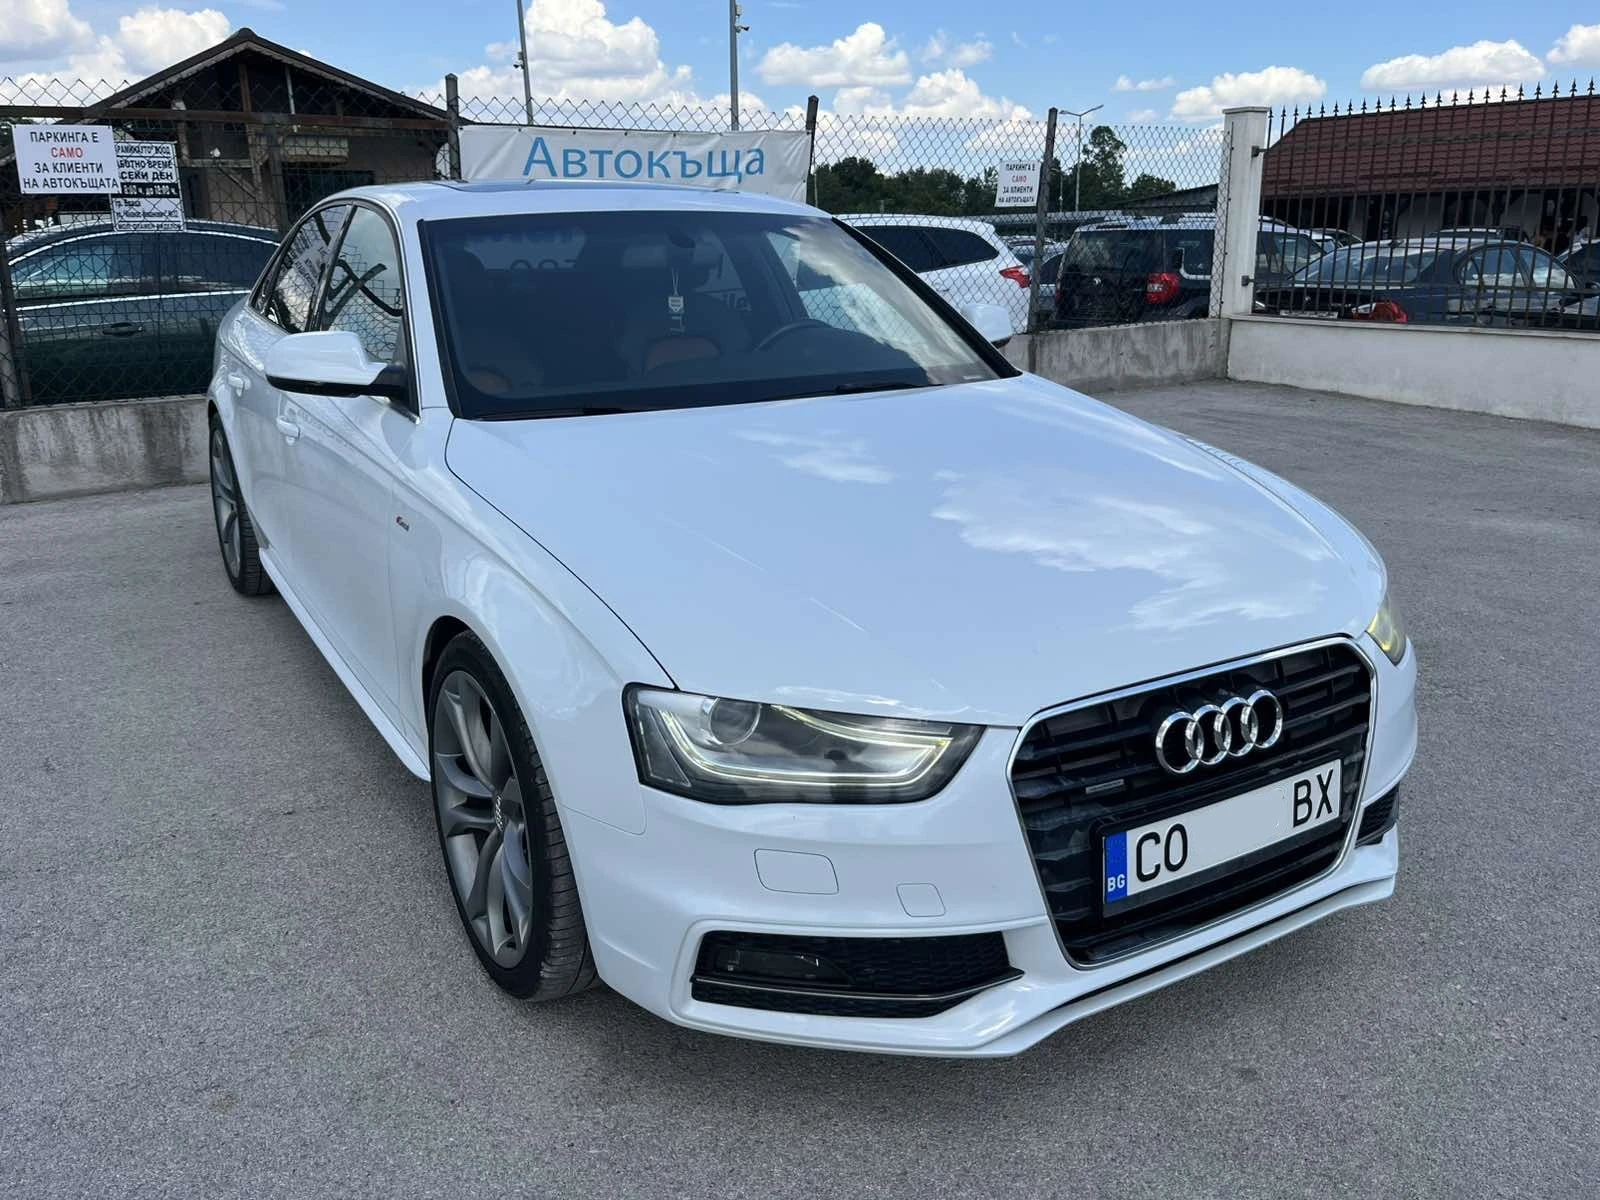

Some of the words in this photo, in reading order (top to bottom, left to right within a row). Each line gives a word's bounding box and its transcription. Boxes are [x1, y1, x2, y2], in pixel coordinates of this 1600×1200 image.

[30, 131, 89, 143] ПАРКИНГА
[92, 132, 99, 143] Е
[51, 146, 83, 158] САМО
[523, 136, 765, 184] Автокъща
[34, 162, 50, 174] ЗА
[52, 162, 104, 174] КЛИЕНТИ
[119, 171, 148, 181] СЕКИ
[23, 178, 39, 189] НА
[42, 177, 119, 190] АВТОКЪЩАТА
[1107, 873, 1126, 893] BG
